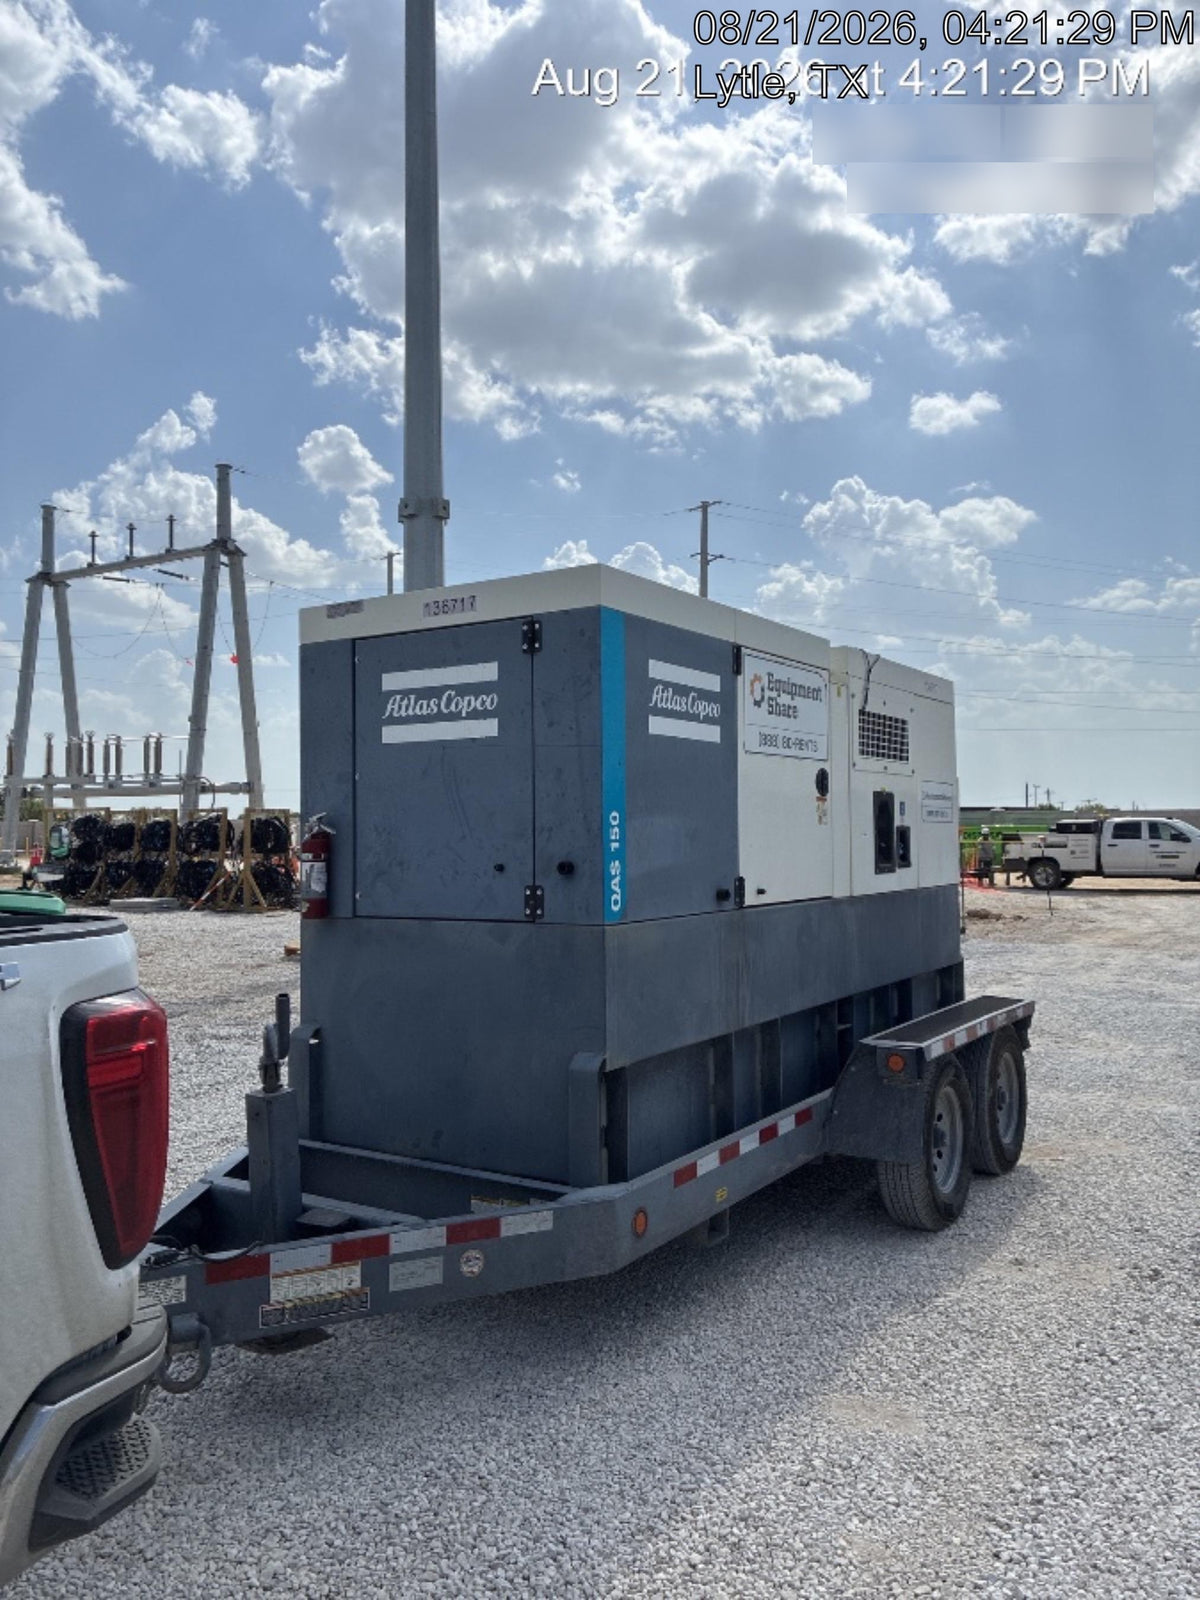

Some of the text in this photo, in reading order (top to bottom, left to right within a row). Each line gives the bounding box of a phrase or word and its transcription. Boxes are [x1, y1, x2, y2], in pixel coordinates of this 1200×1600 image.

[649, 684, 720, 720] Atlas Copco
[767, 672, 823, 703] Equipment
[382, 690, 499, 719] Atlas Copco
[767, 696, 799, 719] Share
[609, 810, 622, 913] QAS 150
